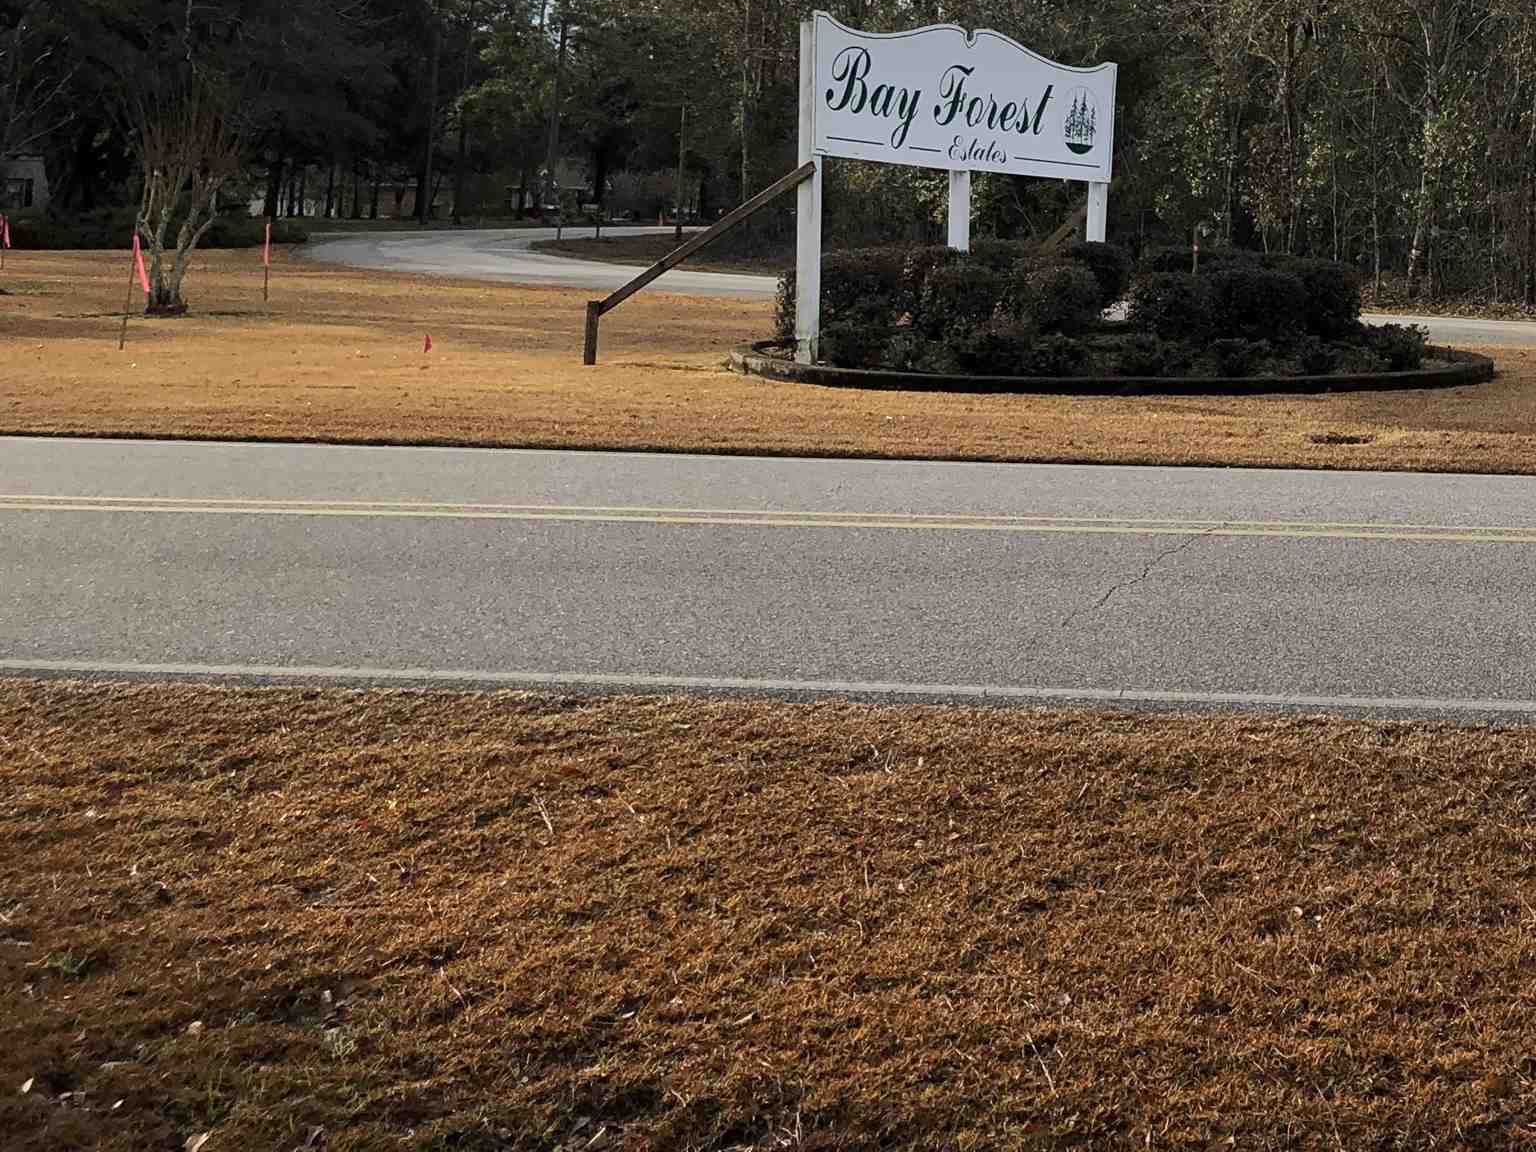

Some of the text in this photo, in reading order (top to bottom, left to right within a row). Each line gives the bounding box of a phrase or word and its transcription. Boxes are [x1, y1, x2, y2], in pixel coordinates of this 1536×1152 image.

[825, 46, 1054, 149] Bay Forest
[947, 135, 1008, 164] Estates
